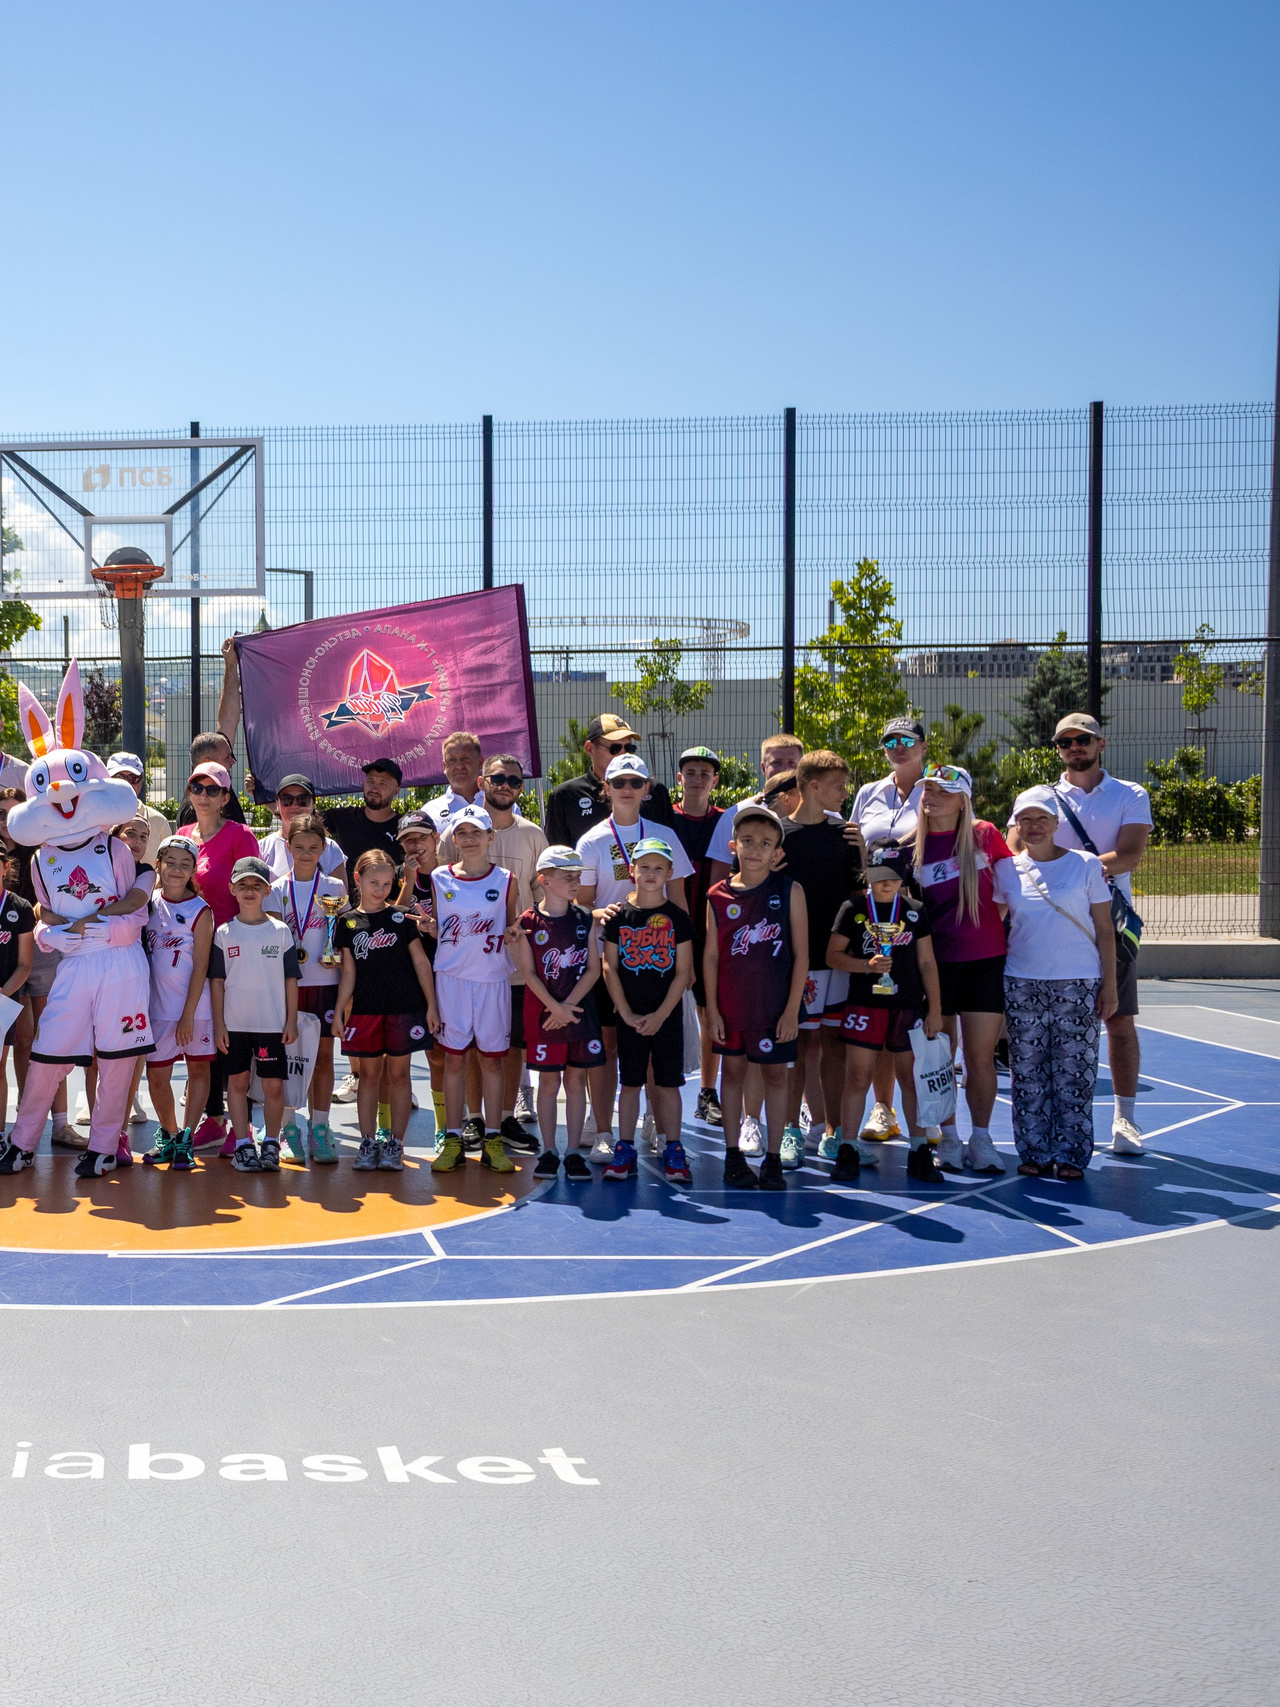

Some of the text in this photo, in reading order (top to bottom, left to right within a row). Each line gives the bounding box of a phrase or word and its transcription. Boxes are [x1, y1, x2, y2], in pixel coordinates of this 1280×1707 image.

[118, 466, 173, 488] ПСБ
[353, 927, 398, 960] Рубин
[483, 935, 504, 954] 51
[619, 927, 676, 949] РУБИН
[772, 940, 783, 957] 7
[171, 949, 181, 968] 1
[121, 1013, 147, 1034] 23
[844, 1014, 870, 1032] 55
[535, 1044, 548, 1062] 5
